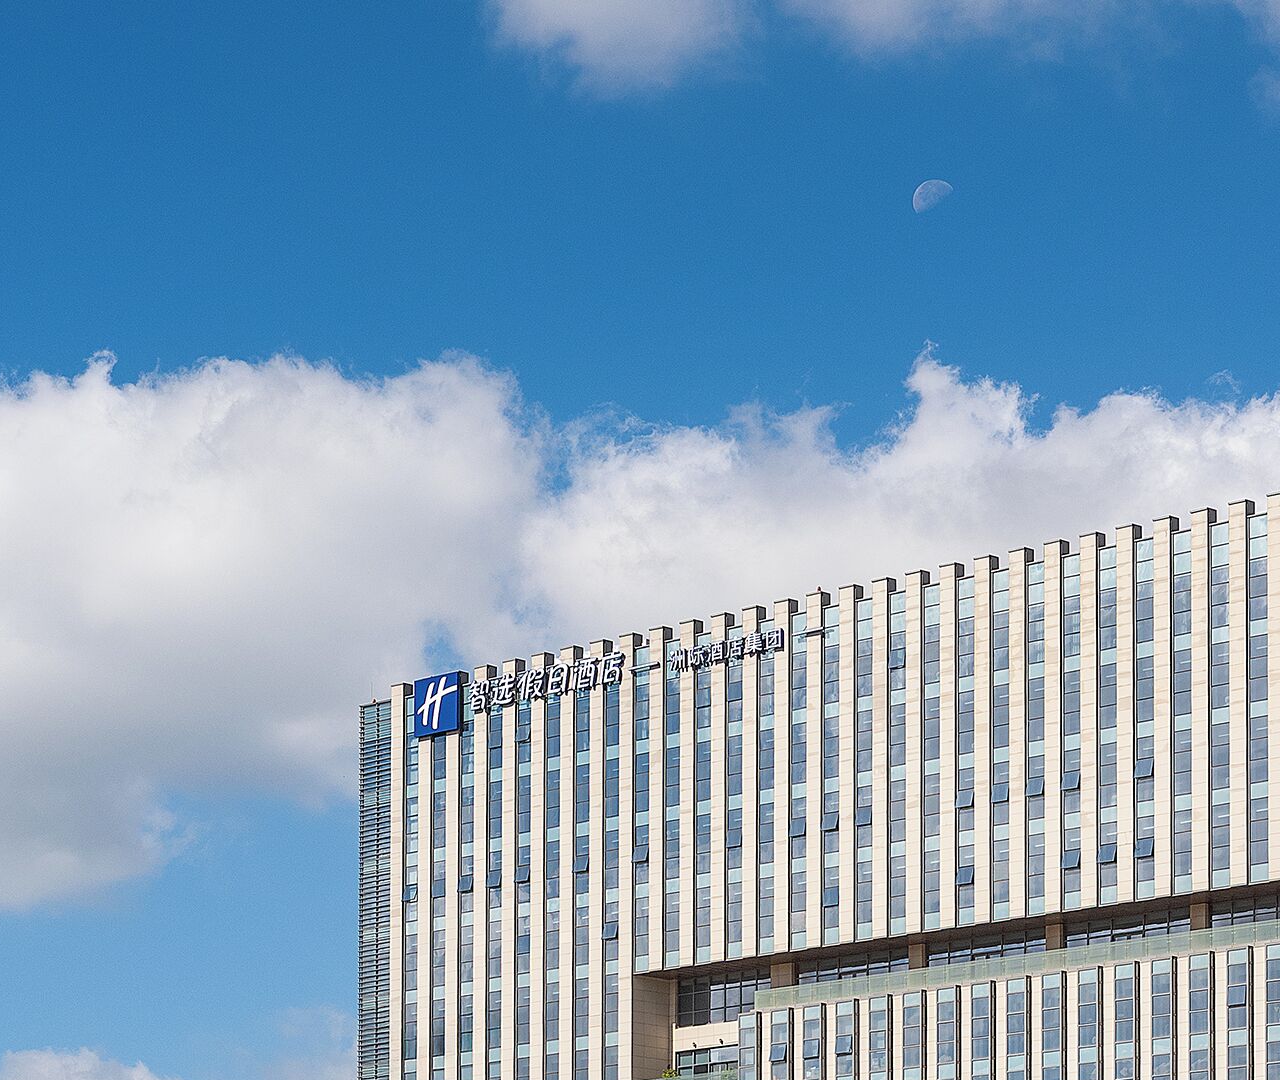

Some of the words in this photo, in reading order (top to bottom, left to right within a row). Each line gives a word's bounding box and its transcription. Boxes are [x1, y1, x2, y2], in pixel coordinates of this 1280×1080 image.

[669, 629, 783, 672] 洲际酒店集团
[468, 652, 625, 713] 智选假日酒店
